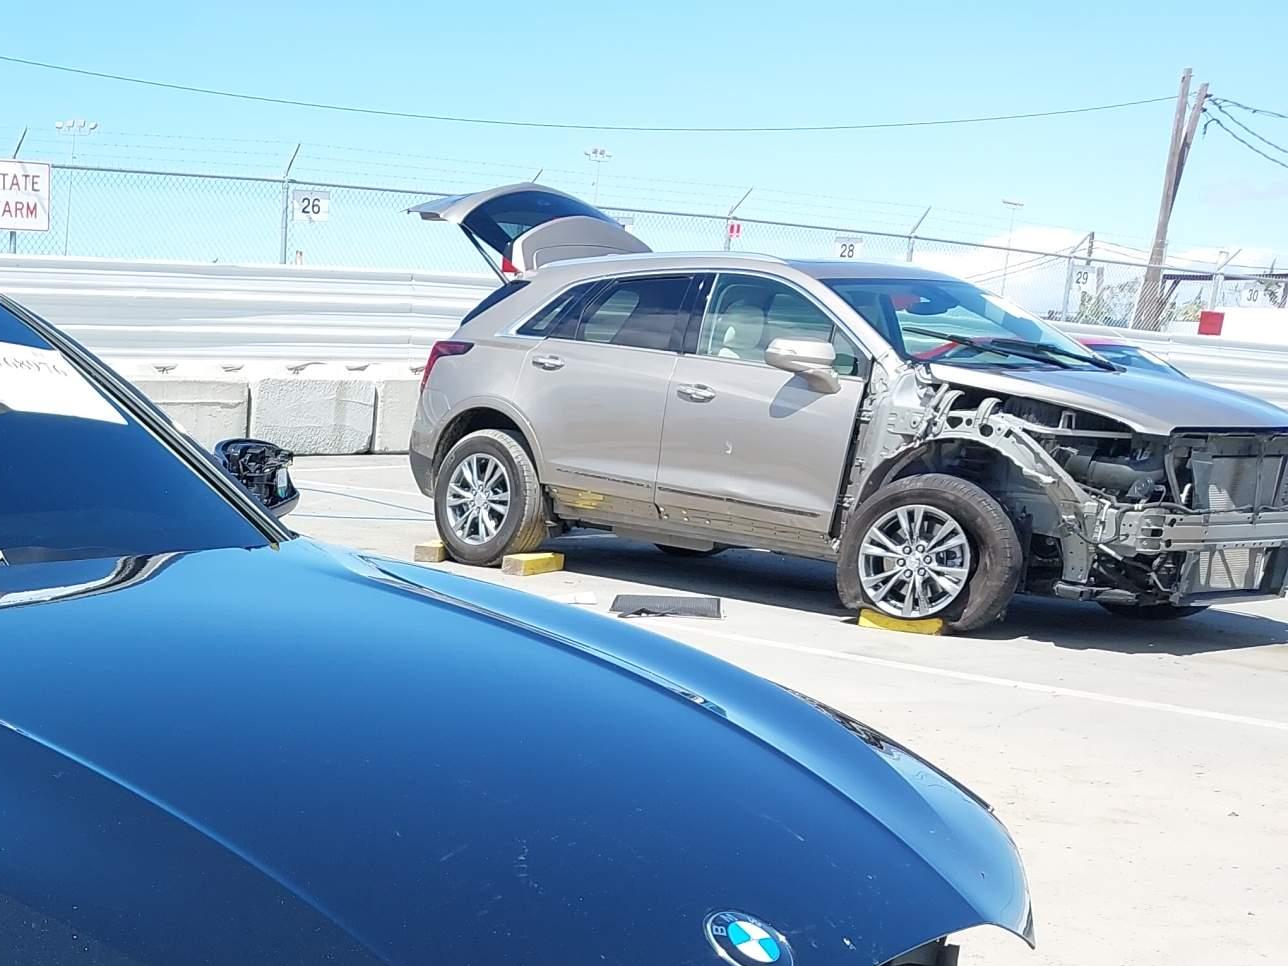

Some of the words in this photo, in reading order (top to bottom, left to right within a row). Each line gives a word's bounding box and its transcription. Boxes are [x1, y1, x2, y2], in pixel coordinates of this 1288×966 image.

[301, 197, 321, 215] 26
[839, 243, 855, 258] 28
[1075, 271, 1089, 285] 29
[1246, 288, 1259, 302] 30
